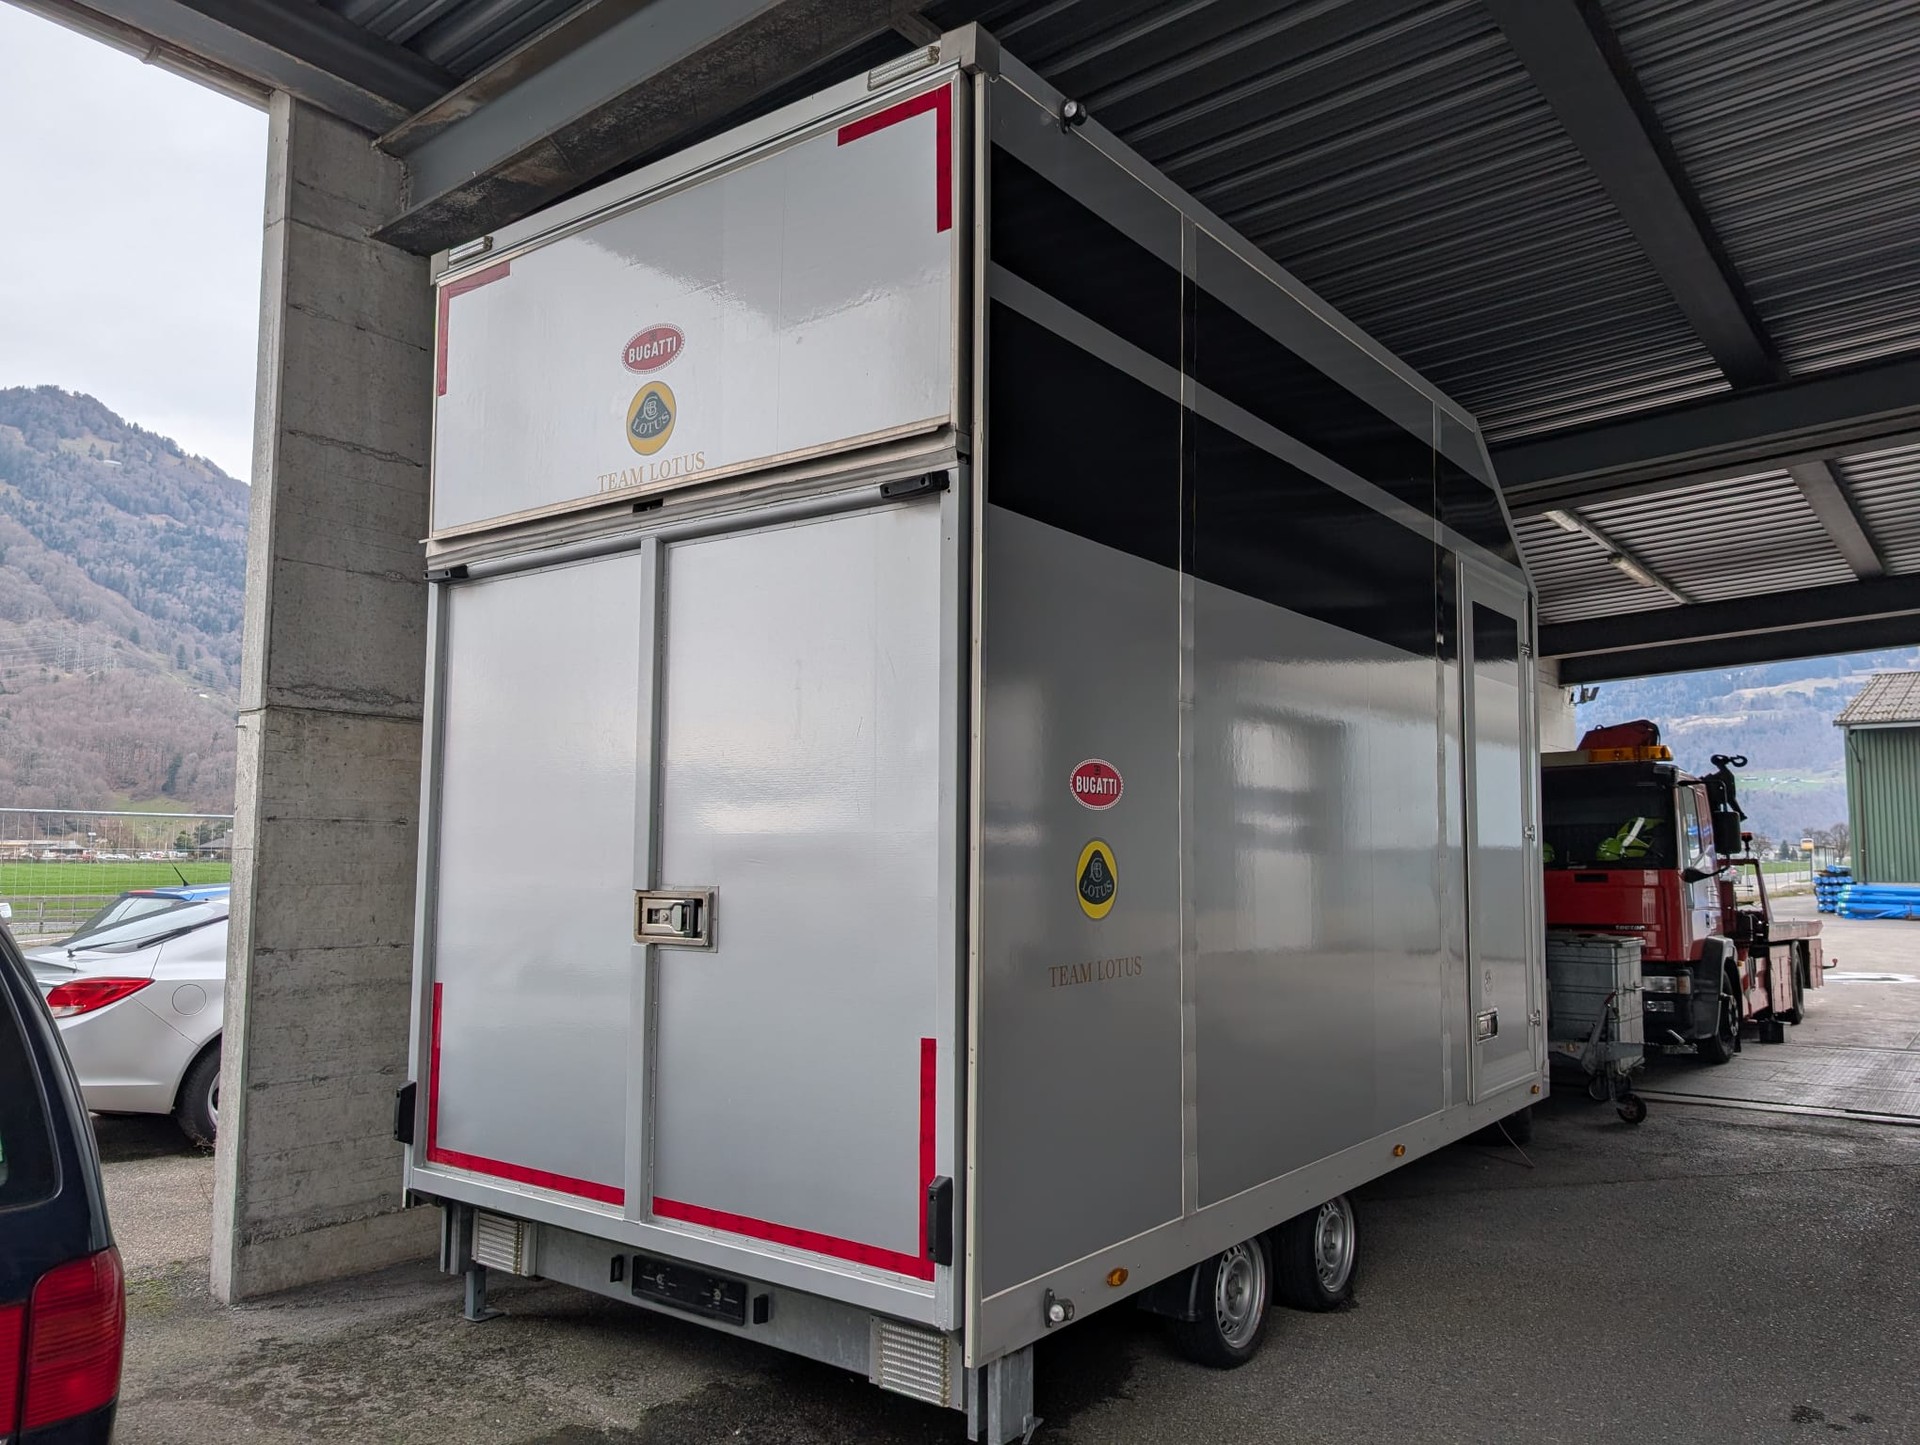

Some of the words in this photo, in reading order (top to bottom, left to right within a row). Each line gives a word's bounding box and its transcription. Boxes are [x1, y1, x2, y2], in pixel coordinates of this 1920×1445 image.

[628, 336, 677, 364] BUGATTI
[632, 410, 670, 435] LOTUS
[597, 465, 644, 493] TEAM
[650, 451, 706, 480] LOTUS
[1076, 775, 1117, 795] BUGATTI
[1081, 879, 1113, 899] LOTUS
[1048, 962, 1092, 988] TEAM
[1097, 956, 1142, 981] LOTUS
